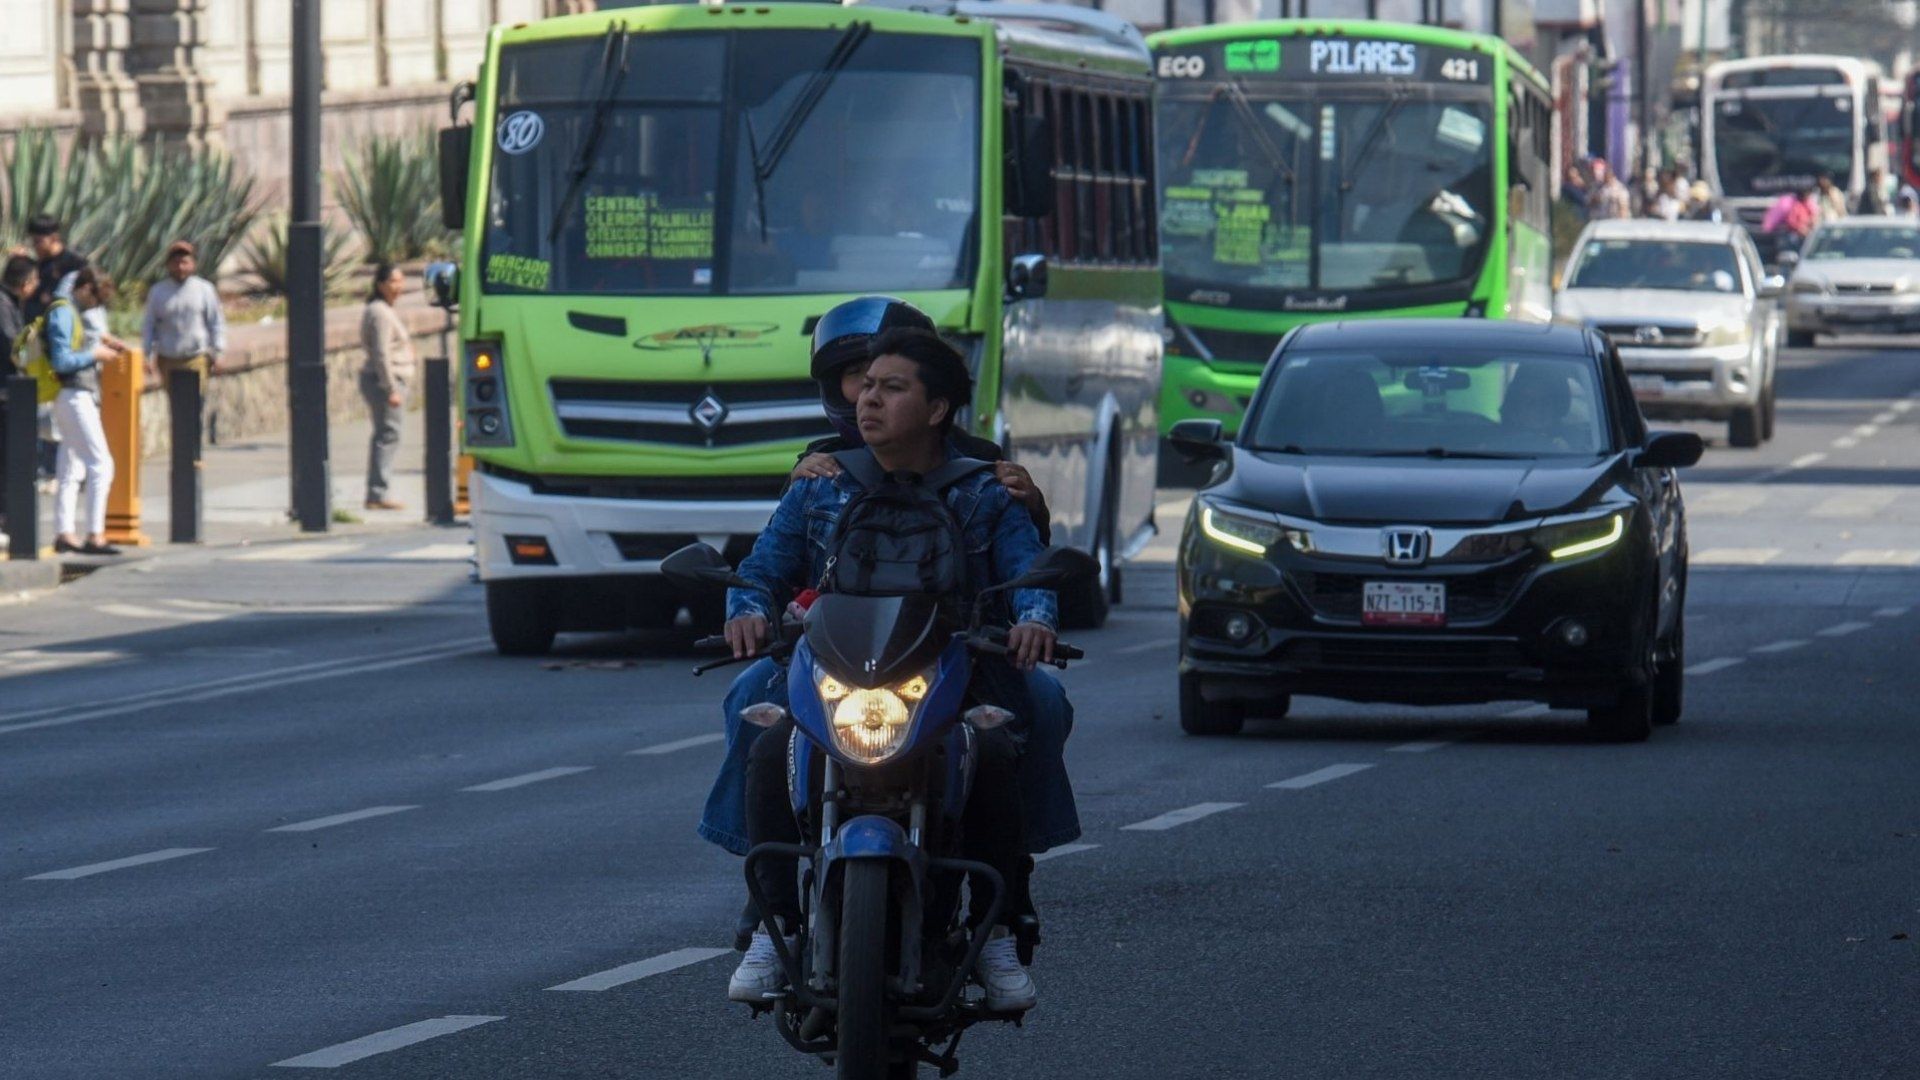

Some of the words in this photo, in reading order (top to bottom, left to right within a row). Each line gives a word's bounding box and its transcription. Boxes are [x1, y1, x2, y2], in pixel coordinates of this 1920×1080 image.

[1158, 56, 1205, 77] ECO
[1310, 41, 1416, 74] PILARES
[1441, 58, 1479, 81] 421
[585, 196, 646, 210] CENTRO
[488, 254, 550, 275] MERCADO
[1367, 594, 1441, 612] NZT-115-A
